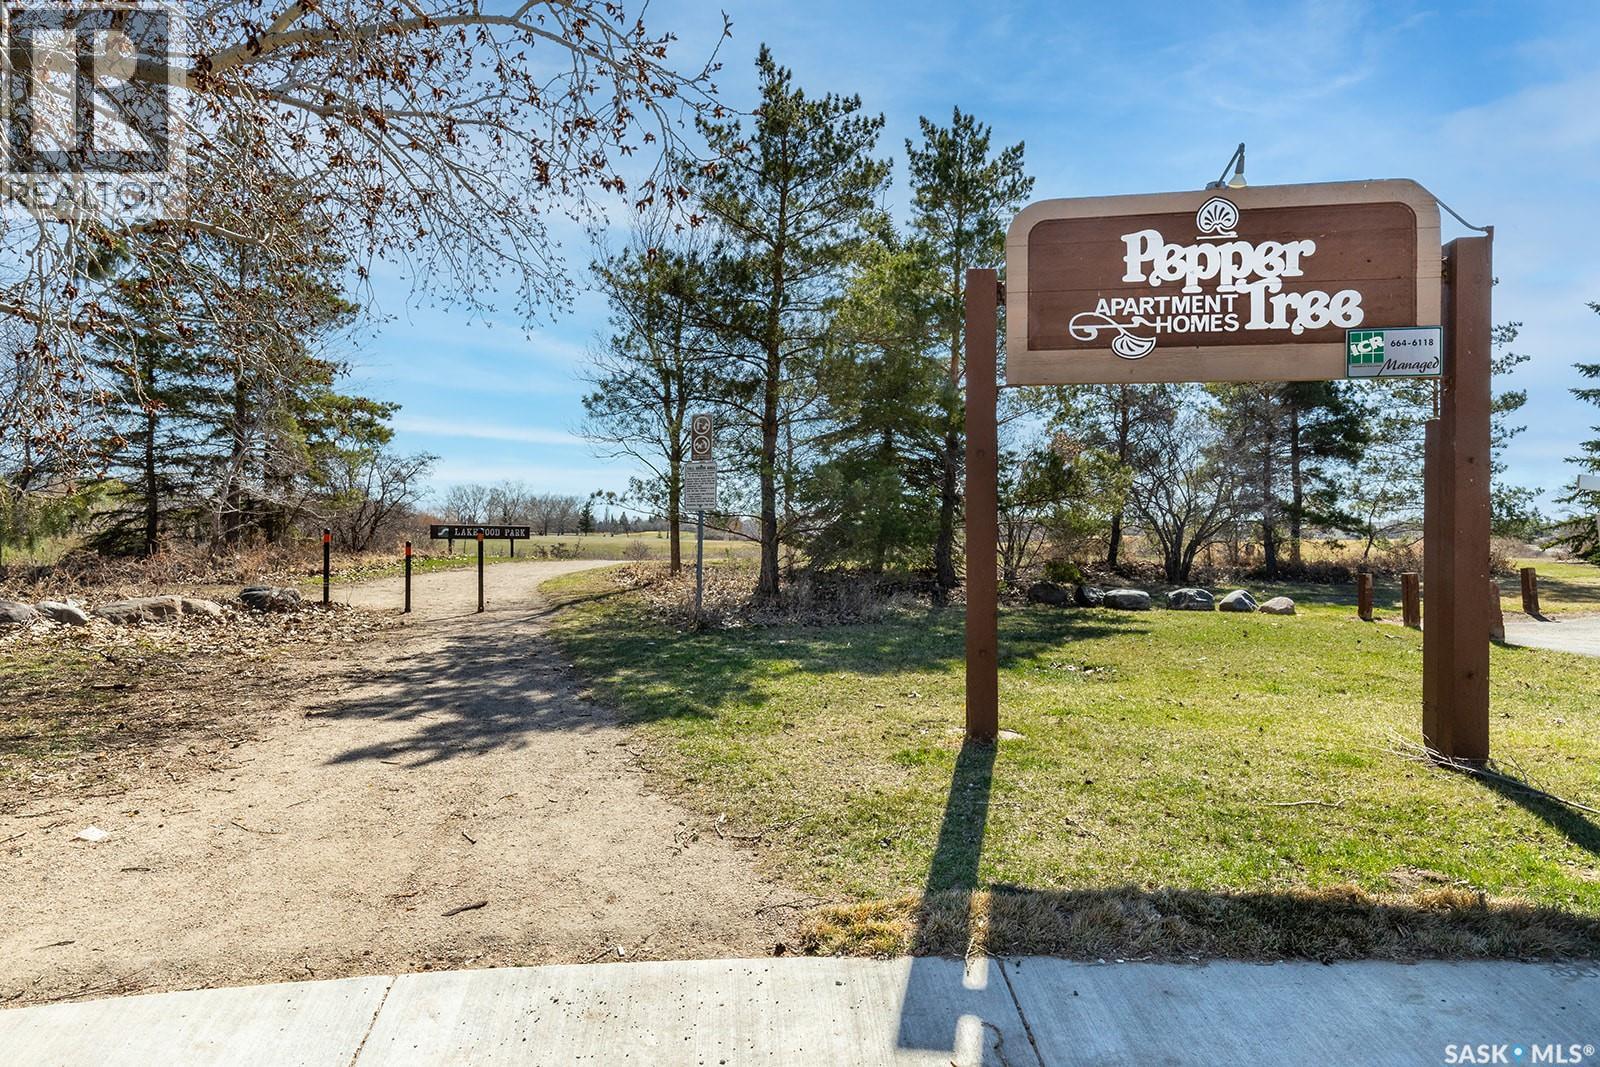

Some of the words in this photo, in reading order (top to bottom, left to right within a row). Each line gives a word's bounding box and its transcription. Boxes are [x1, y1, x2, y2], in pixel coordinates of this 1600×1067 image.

[1121, 229, 1316, 293] Pepper
[1094, 294, 1238, 317] APARTMENT
[1236, 277, 1365, 335] Tree
[1156, 313, 1240, 334] HOMES
[1350, 336, 1385, 356] ICR
[1390, 338, 1434, 348] 664-6118
[1377, 356, 1440, 377] Managed
[454, 528, 501, 537] LAKEOOD
[504, 528, 526, 537] PARK
